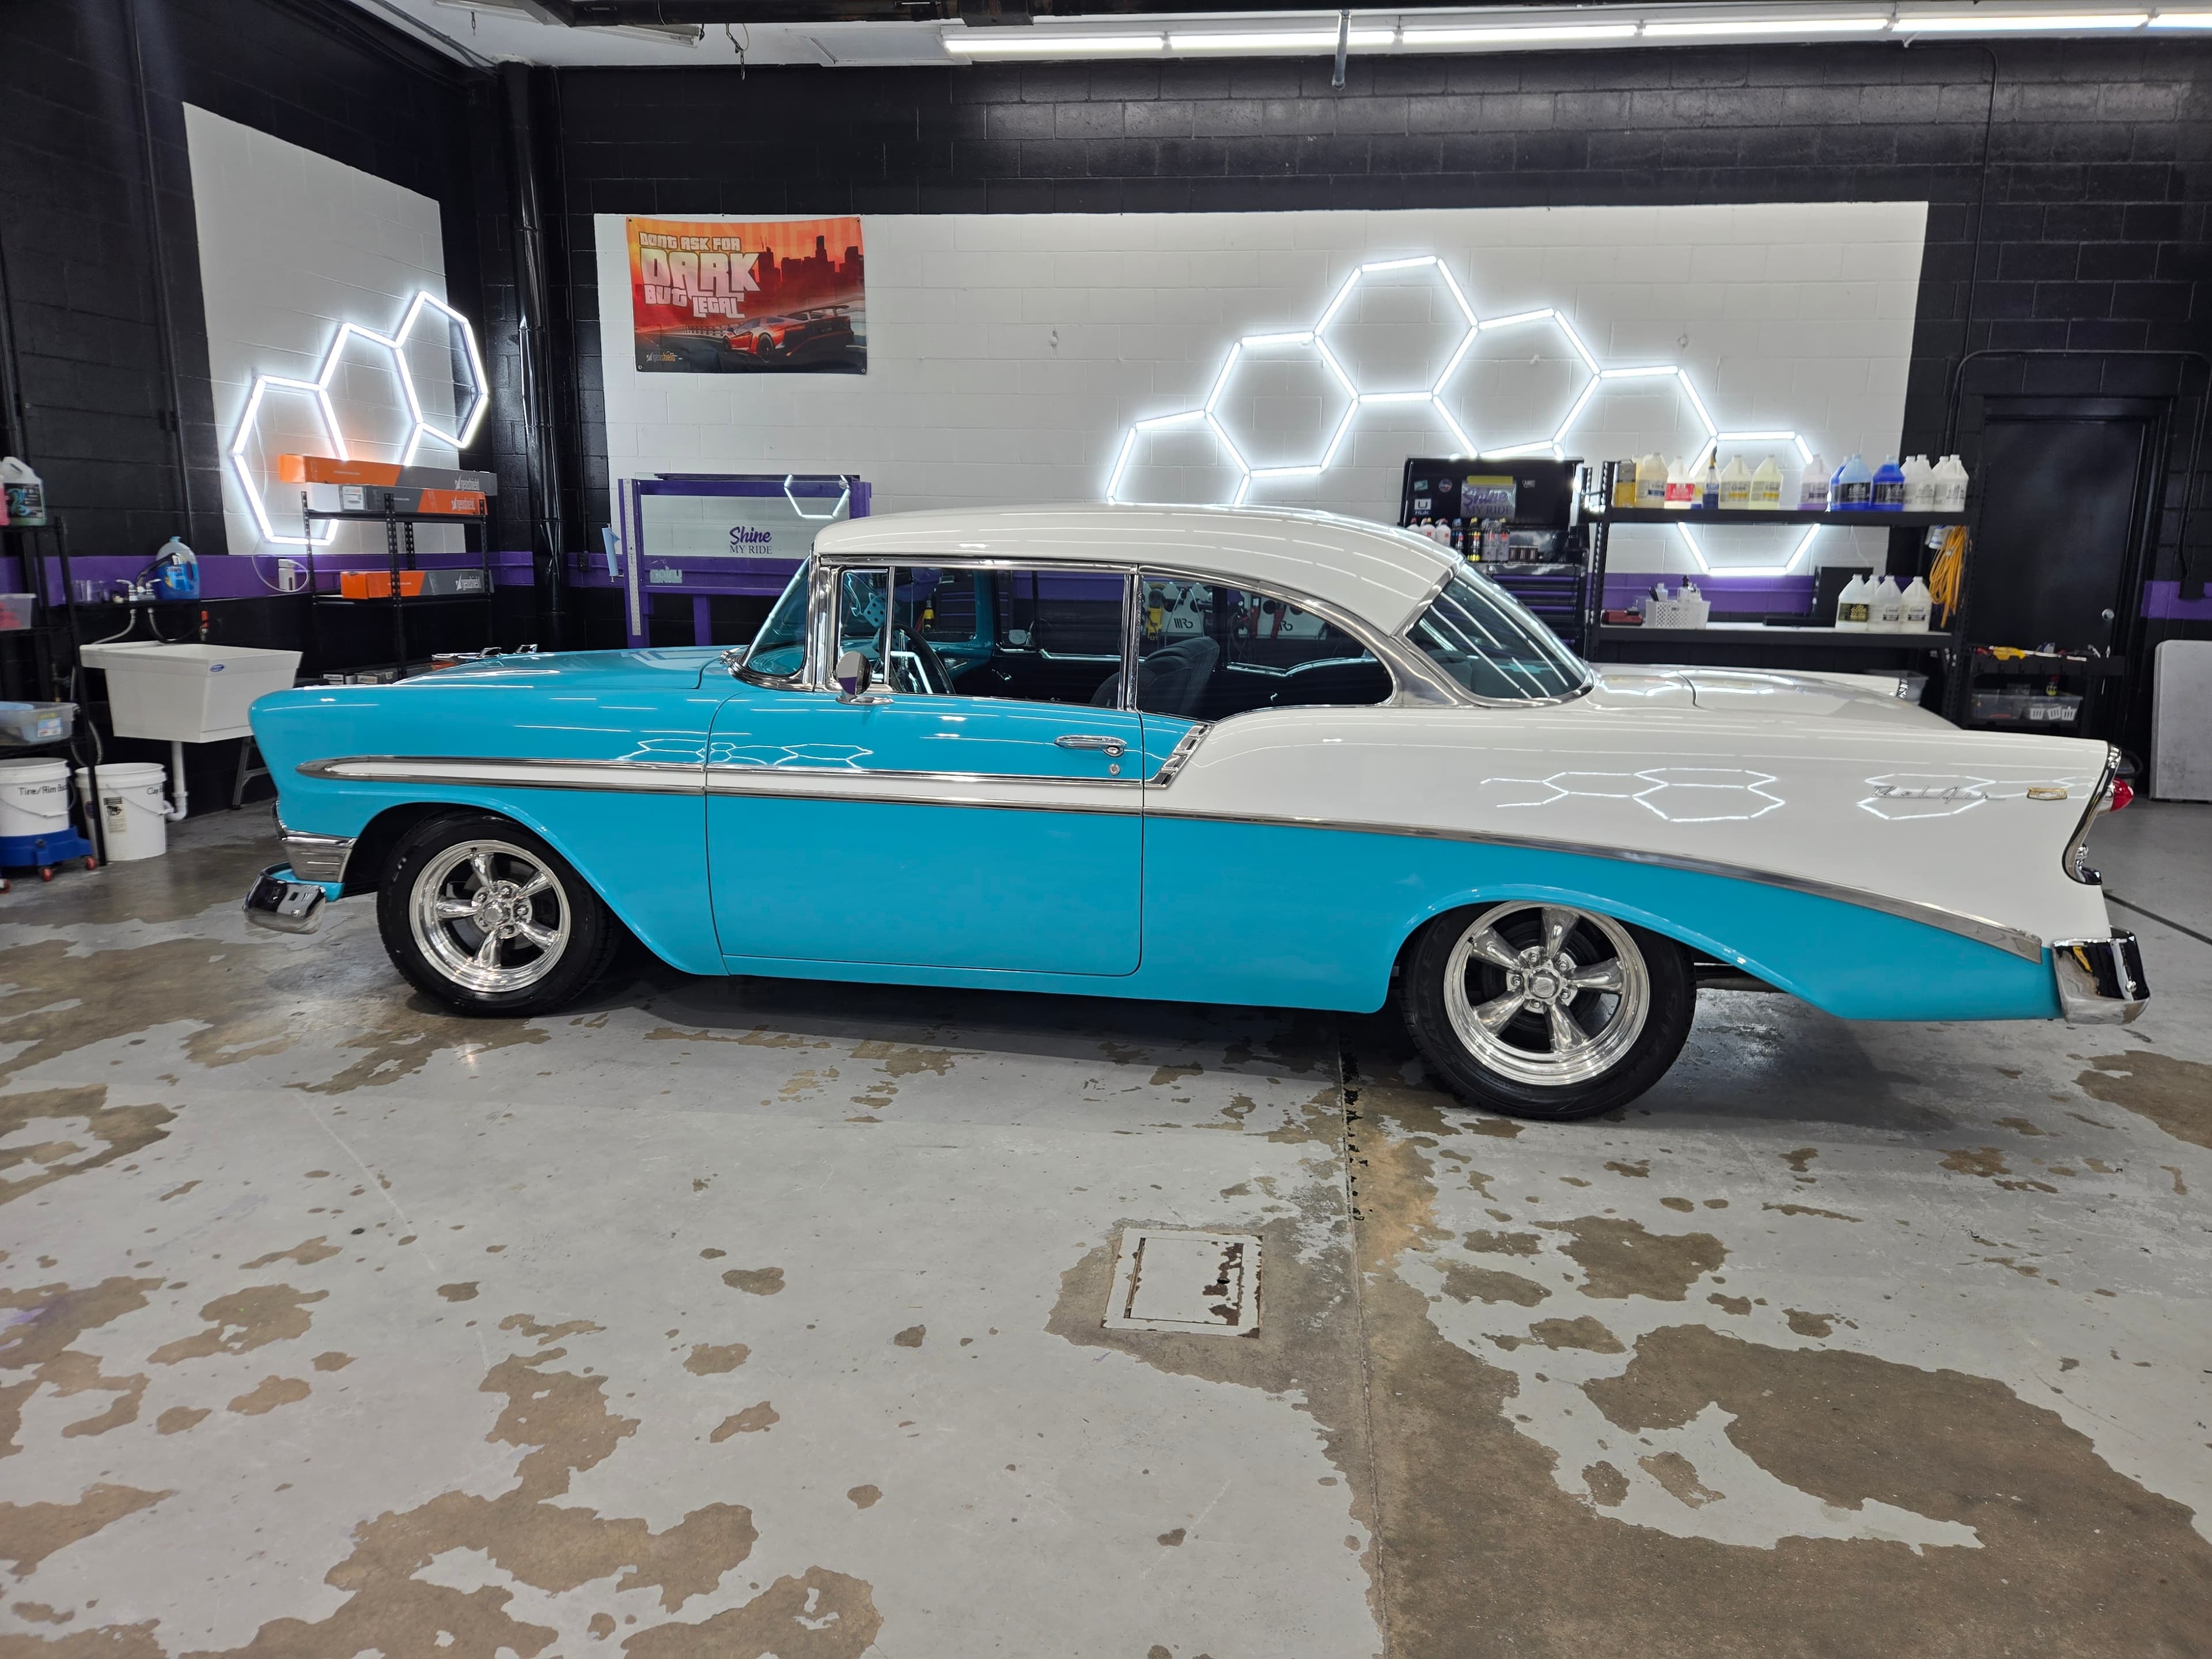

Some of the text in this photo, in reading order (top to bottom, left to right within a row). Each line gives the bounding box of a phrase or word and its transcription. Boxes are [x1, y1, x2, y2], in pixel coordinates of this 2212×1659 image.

[680, 236, 710, 251] ASK
[713, 236, 741, 251] FOR
[640, 247, 761, 301] DARK
[692, 296, 745, 318] LEGAL
[1465, 506, 1512, 514] MY RIDE
[729, 526, 772, 545] Shine
[730, 545, 772, 555] MY RIDE
